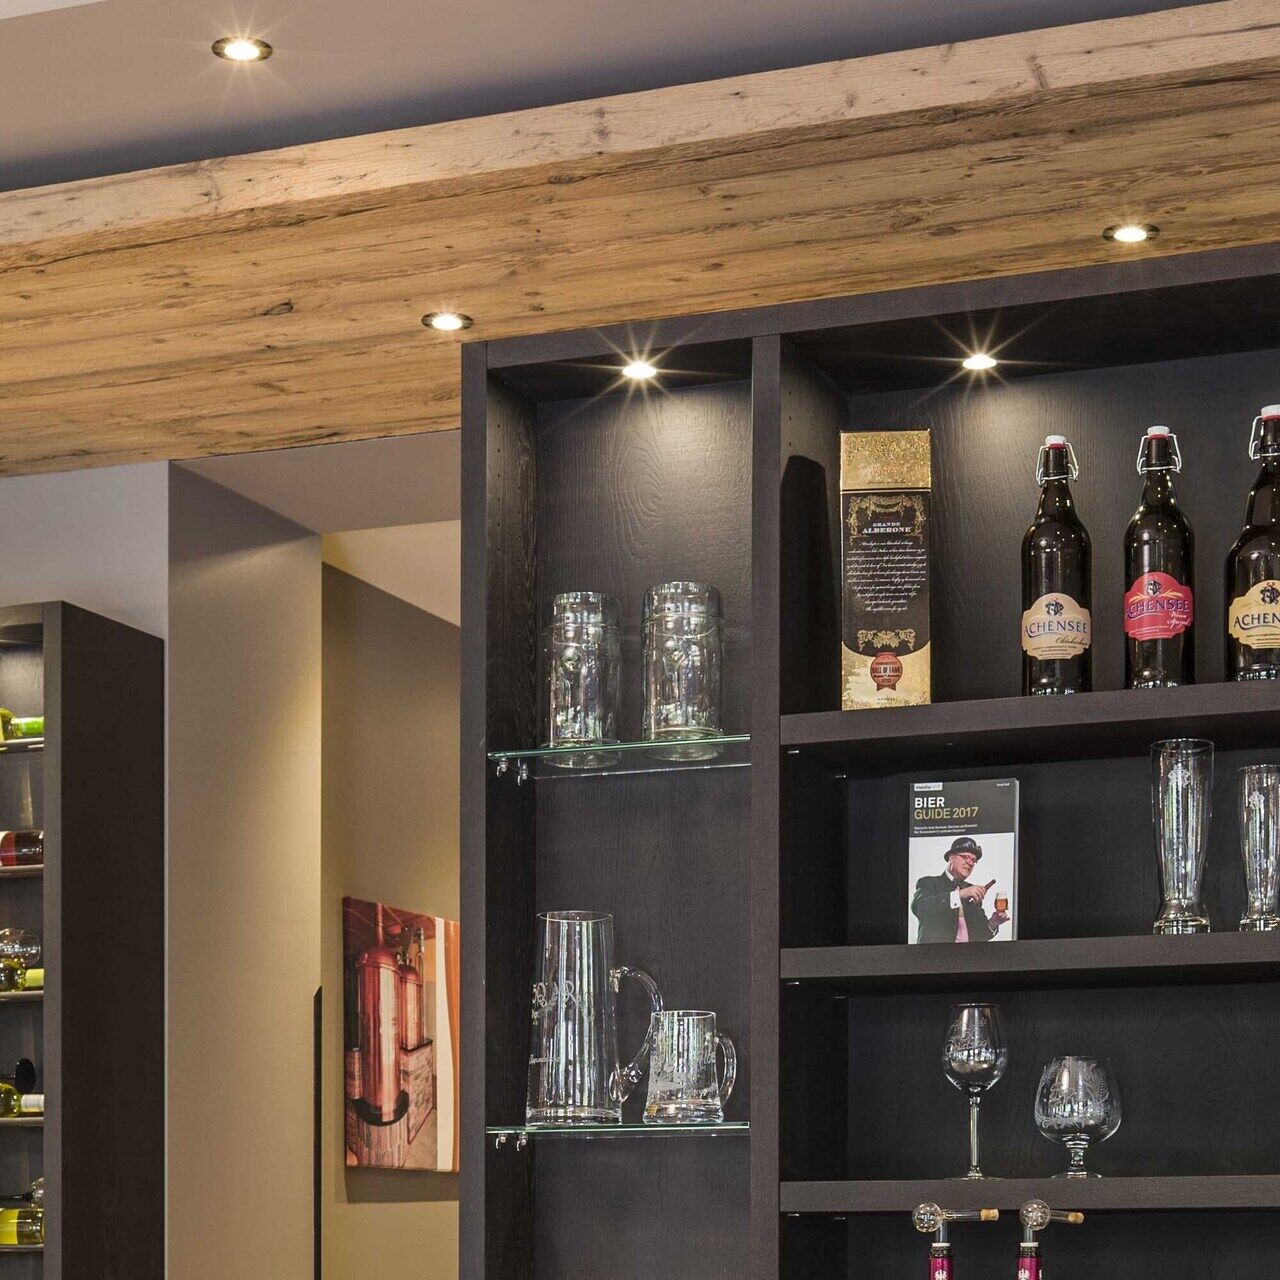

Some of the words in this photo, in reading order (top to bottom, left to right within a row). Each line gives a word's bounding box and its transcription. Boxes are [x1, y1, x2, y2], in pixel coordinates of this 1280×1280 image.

[861, 526, 912, 534] ALBERONE
[1124, 599, 1190, 619] ACHENSEE
[1024, 620, 1088, 638] ACHENSEE
[914, 796, 946, 809] BIER
[914, 808, 951, 820] GUIDE
[952, 806, 979, 819] 2017
